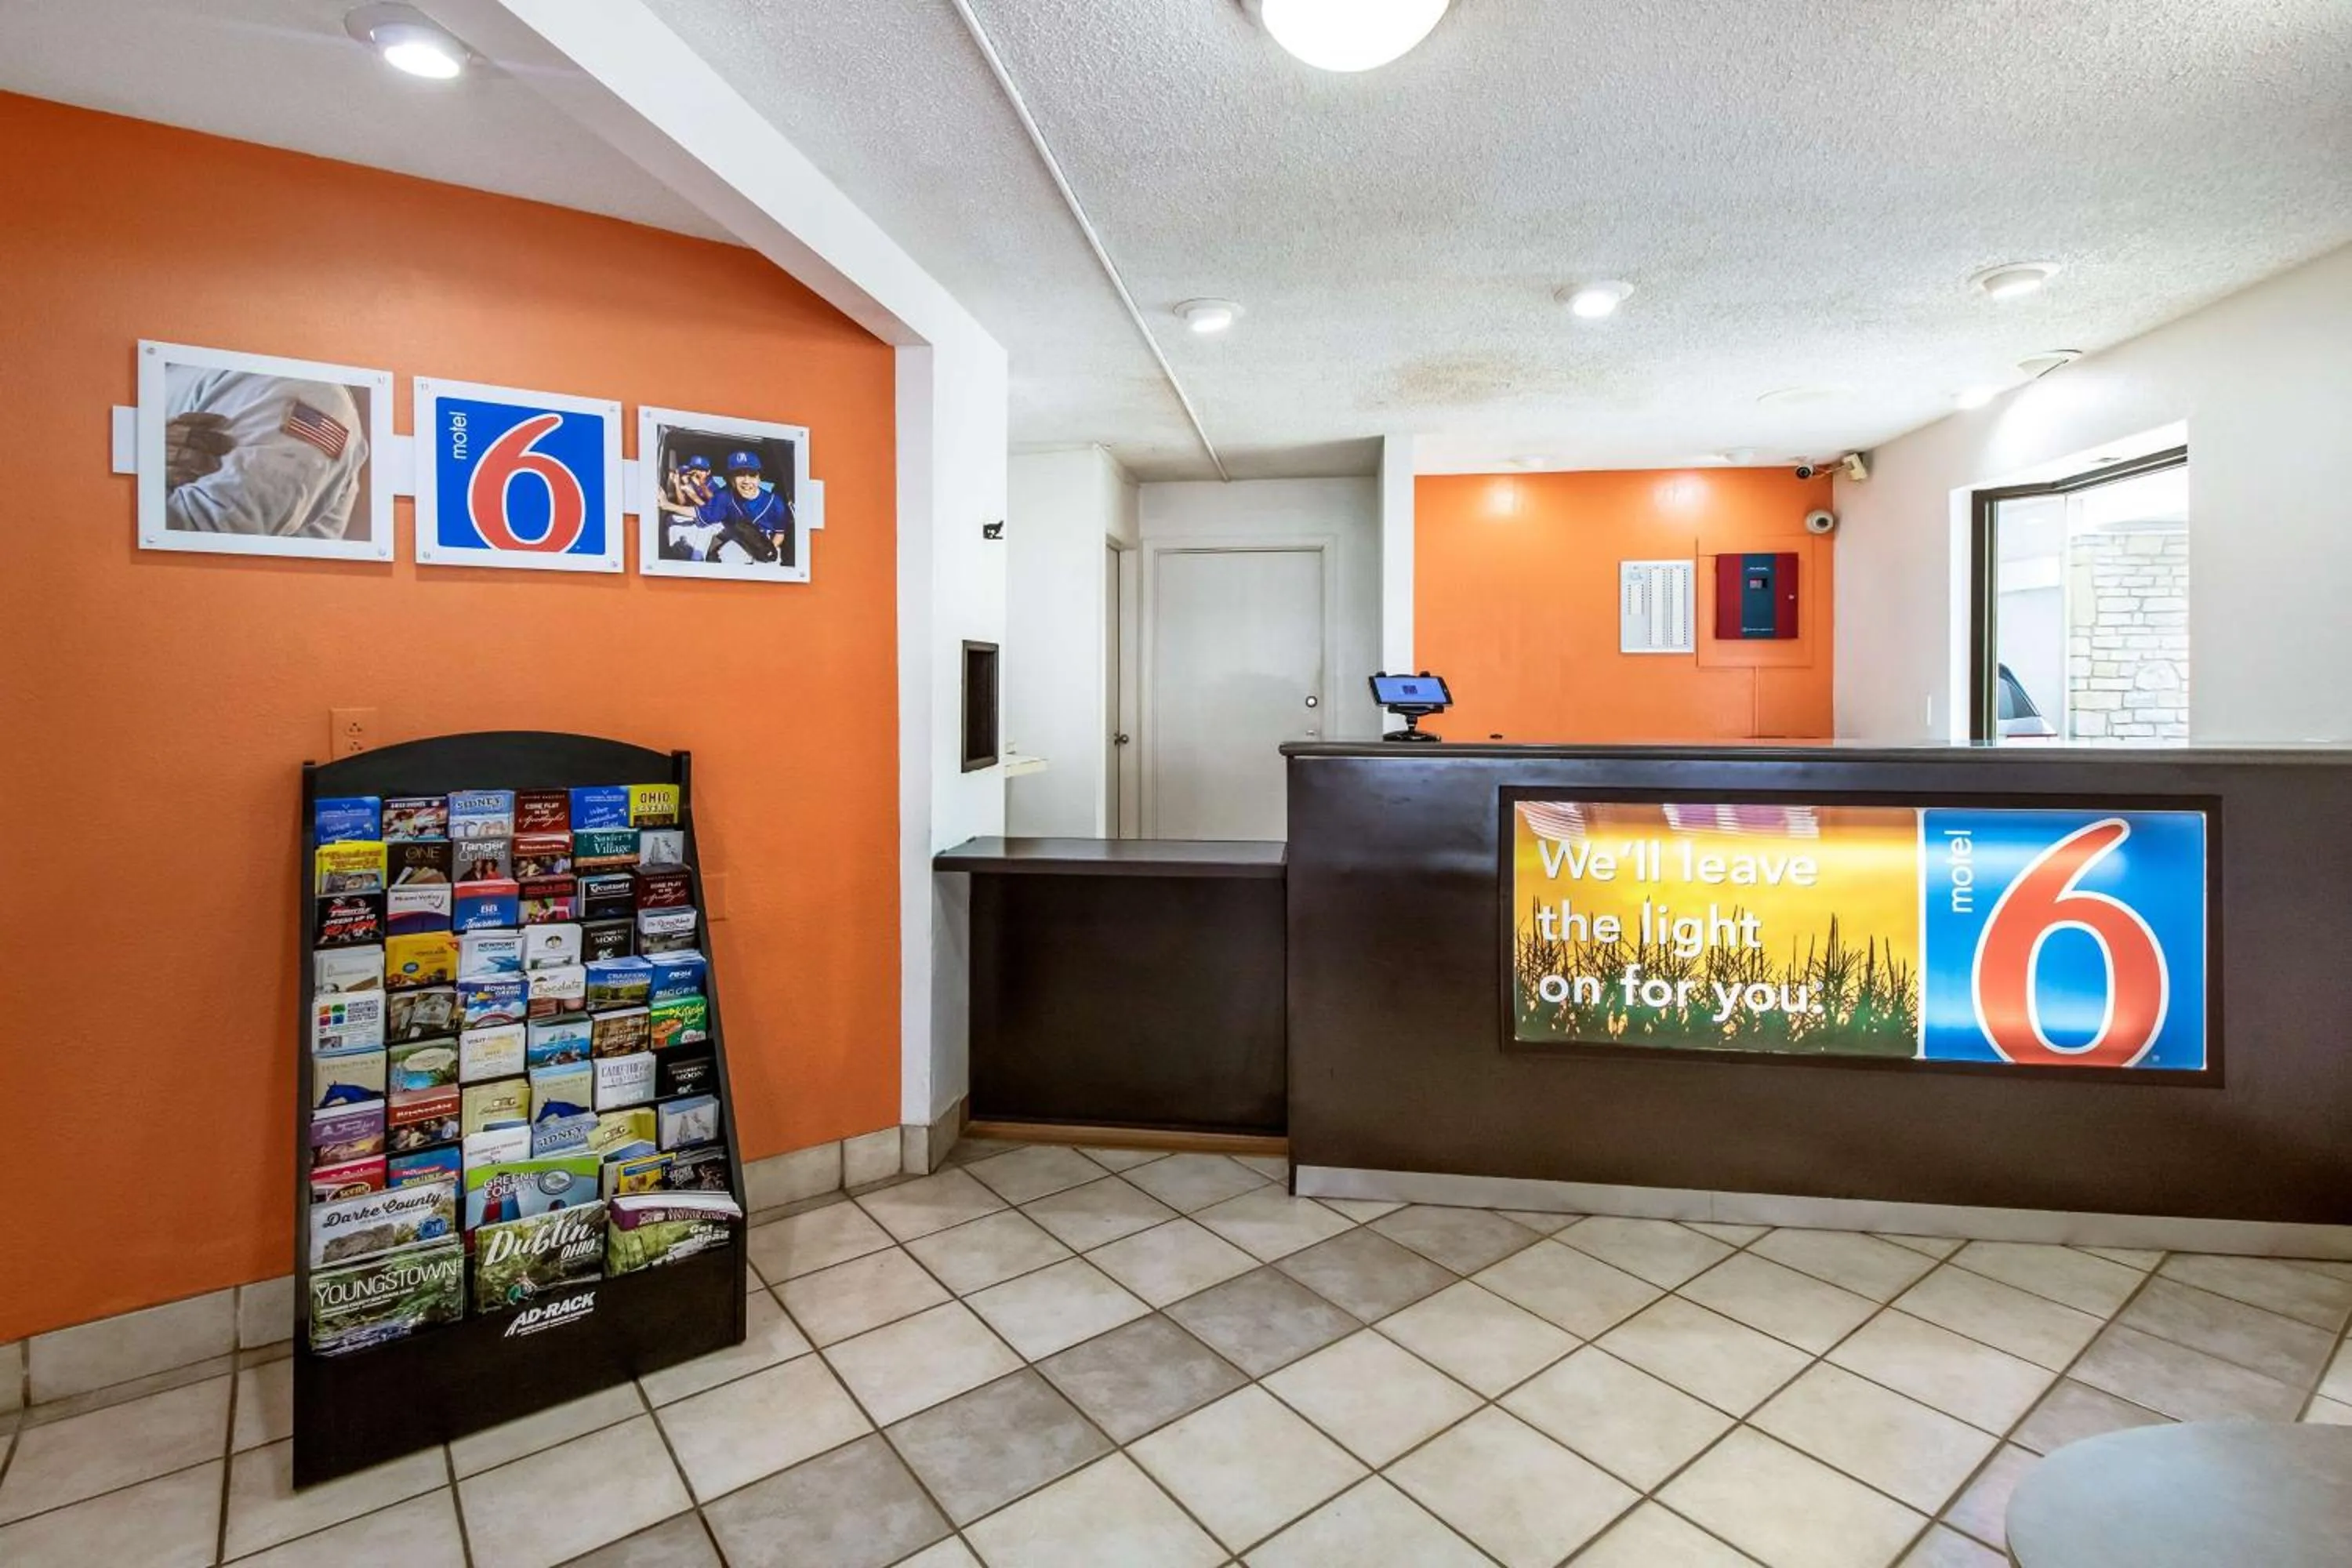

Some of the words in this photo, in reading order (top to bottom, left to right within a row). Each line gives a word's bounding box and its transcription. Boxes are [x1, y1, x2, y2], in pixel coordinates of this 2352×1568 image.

[448, 411, 468, 460] motel
[467, 412, 586, 554] 6
[459, 841, 506, 853] Tanger
[459, 850, 506, 861] Outlets
[594, 843, 631, 855] Village
[1537, 839, 1661, 882] We'll
[1682, 840, 1818, 885] leave
[1537, 898, 1621, 943] the
[1642, 899, 1762, 958] light
[1944, 829, 1973, 913] motel
[1971, 818, 2169, 1067] 6
[1538, 974, 1601, 1004] on
[1620, 964, 1696, 1007] for
[484, 1172, 536, 1188] GREENE
[484, 1181, 536, 1199] COUNTY
[322, 1207, 381, 1228] Darke
[383, 1192, 443, 1214] County
[561, 1239, 595, 1260] OHIO
[316, 1258, 457, 1308] YOUNGSTOWN
[504, 1292, 596, 1338] AD-RACK
